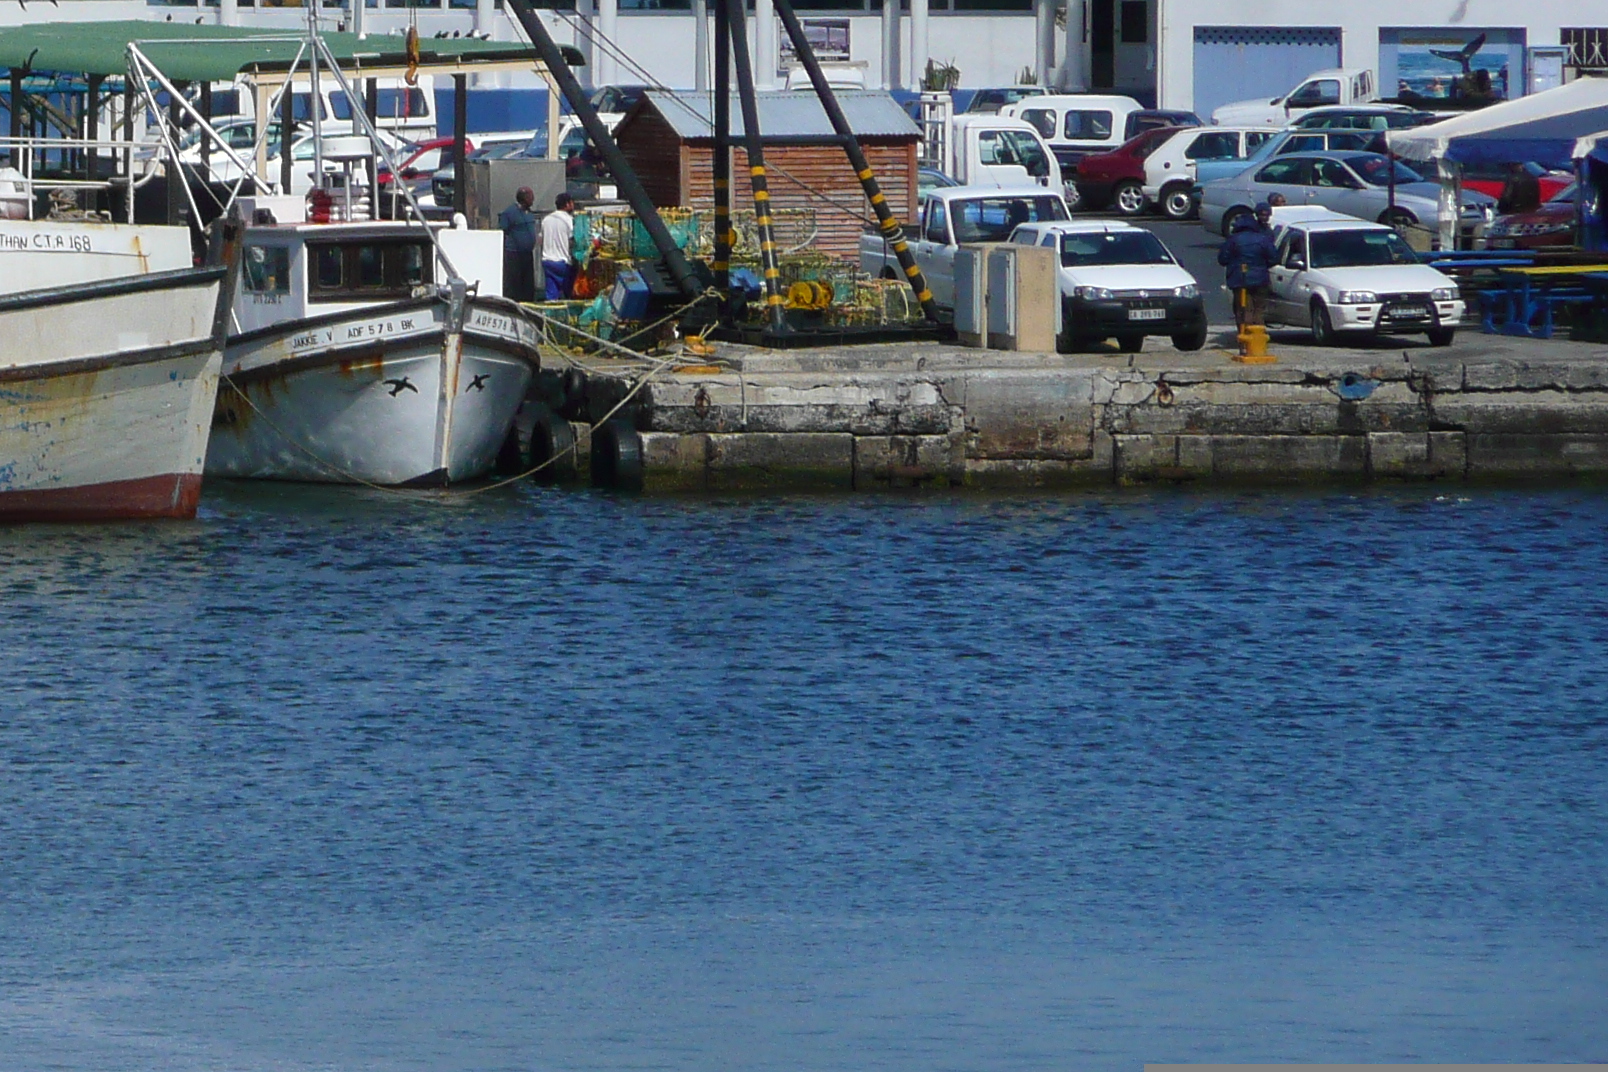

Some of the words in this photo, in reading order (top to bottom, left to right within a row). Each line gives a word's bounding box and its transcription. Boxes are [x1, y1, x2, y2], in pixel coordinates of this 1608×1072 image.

[70, 235, 91, 251] 168
[348, 326, 364, 339] ADF
[401, 319, 415, 330] BK
